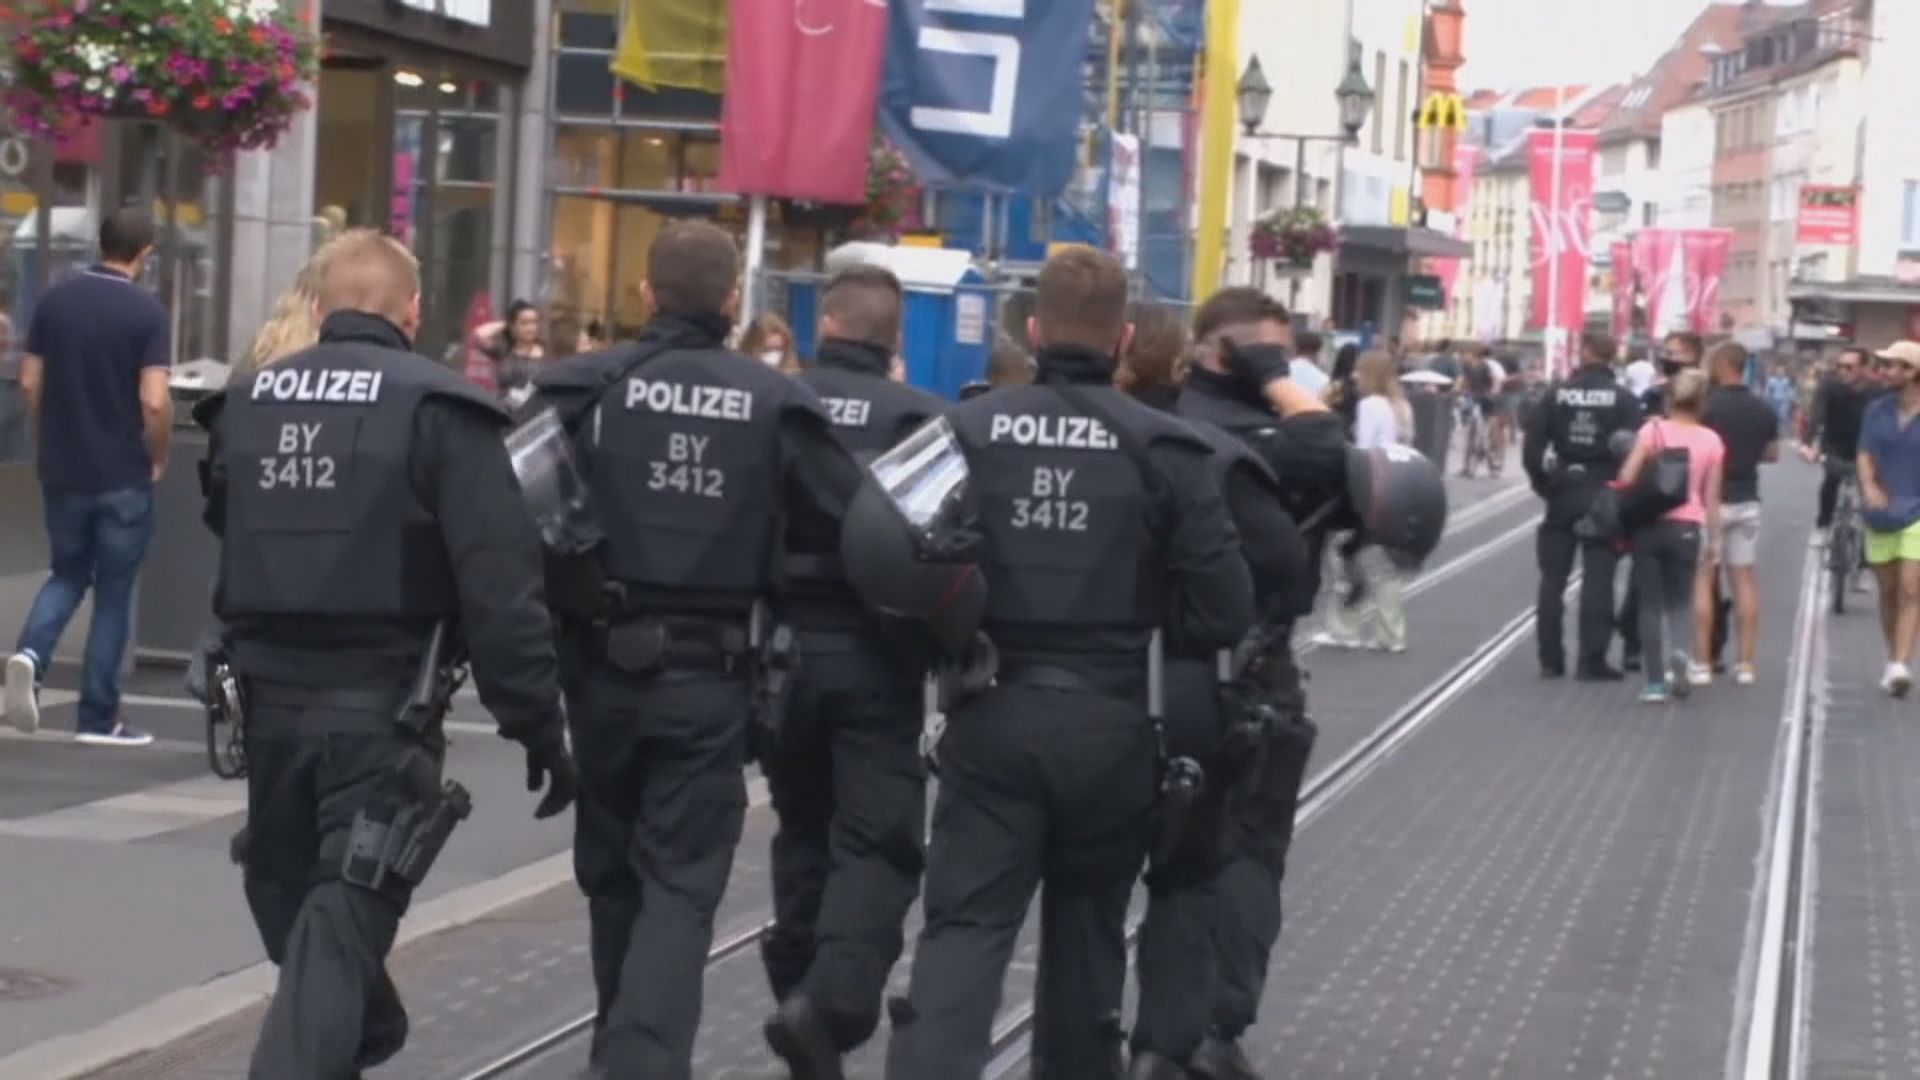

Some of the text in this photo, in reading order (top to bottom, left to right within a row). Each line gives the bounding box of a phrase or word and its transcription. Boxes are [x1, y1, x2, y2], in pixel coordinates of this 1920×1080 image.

[251, 368, 382, 402] POLIZEI
[625, 378, 752, 420] POLIZEI
[821, 397, 870, 426] ZEI
[278, 423, 322, 453] BY
[669, 432, 709, 463] BY
[259, 456, 336, 488] 3412
[647, 461, 724, 498] 3412
[1032, 467, 1074, 497] BY
[1010, 498, 1089, 530] 3412
